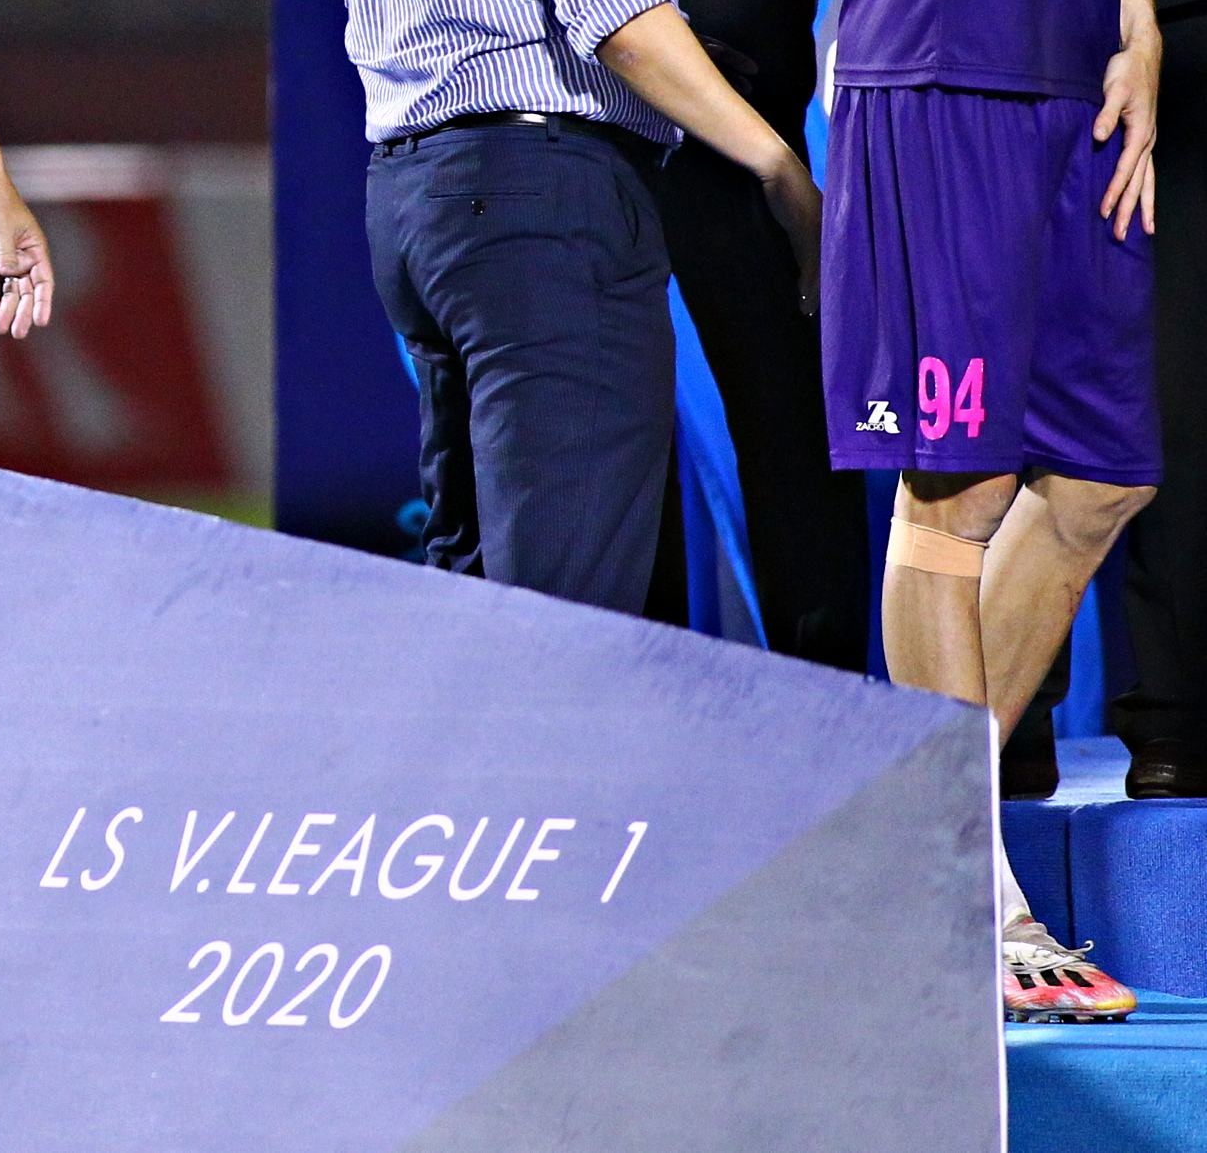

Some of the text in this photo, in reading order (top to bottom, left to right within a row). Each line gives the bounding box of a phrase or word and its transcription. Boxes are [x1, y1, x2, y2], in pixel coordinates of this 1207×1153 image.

[918, 356, 985, 440] 94
[39, 807, 648, 904] LS V.LEAGUE 1
[159, 940, 392, 1029] 2020
